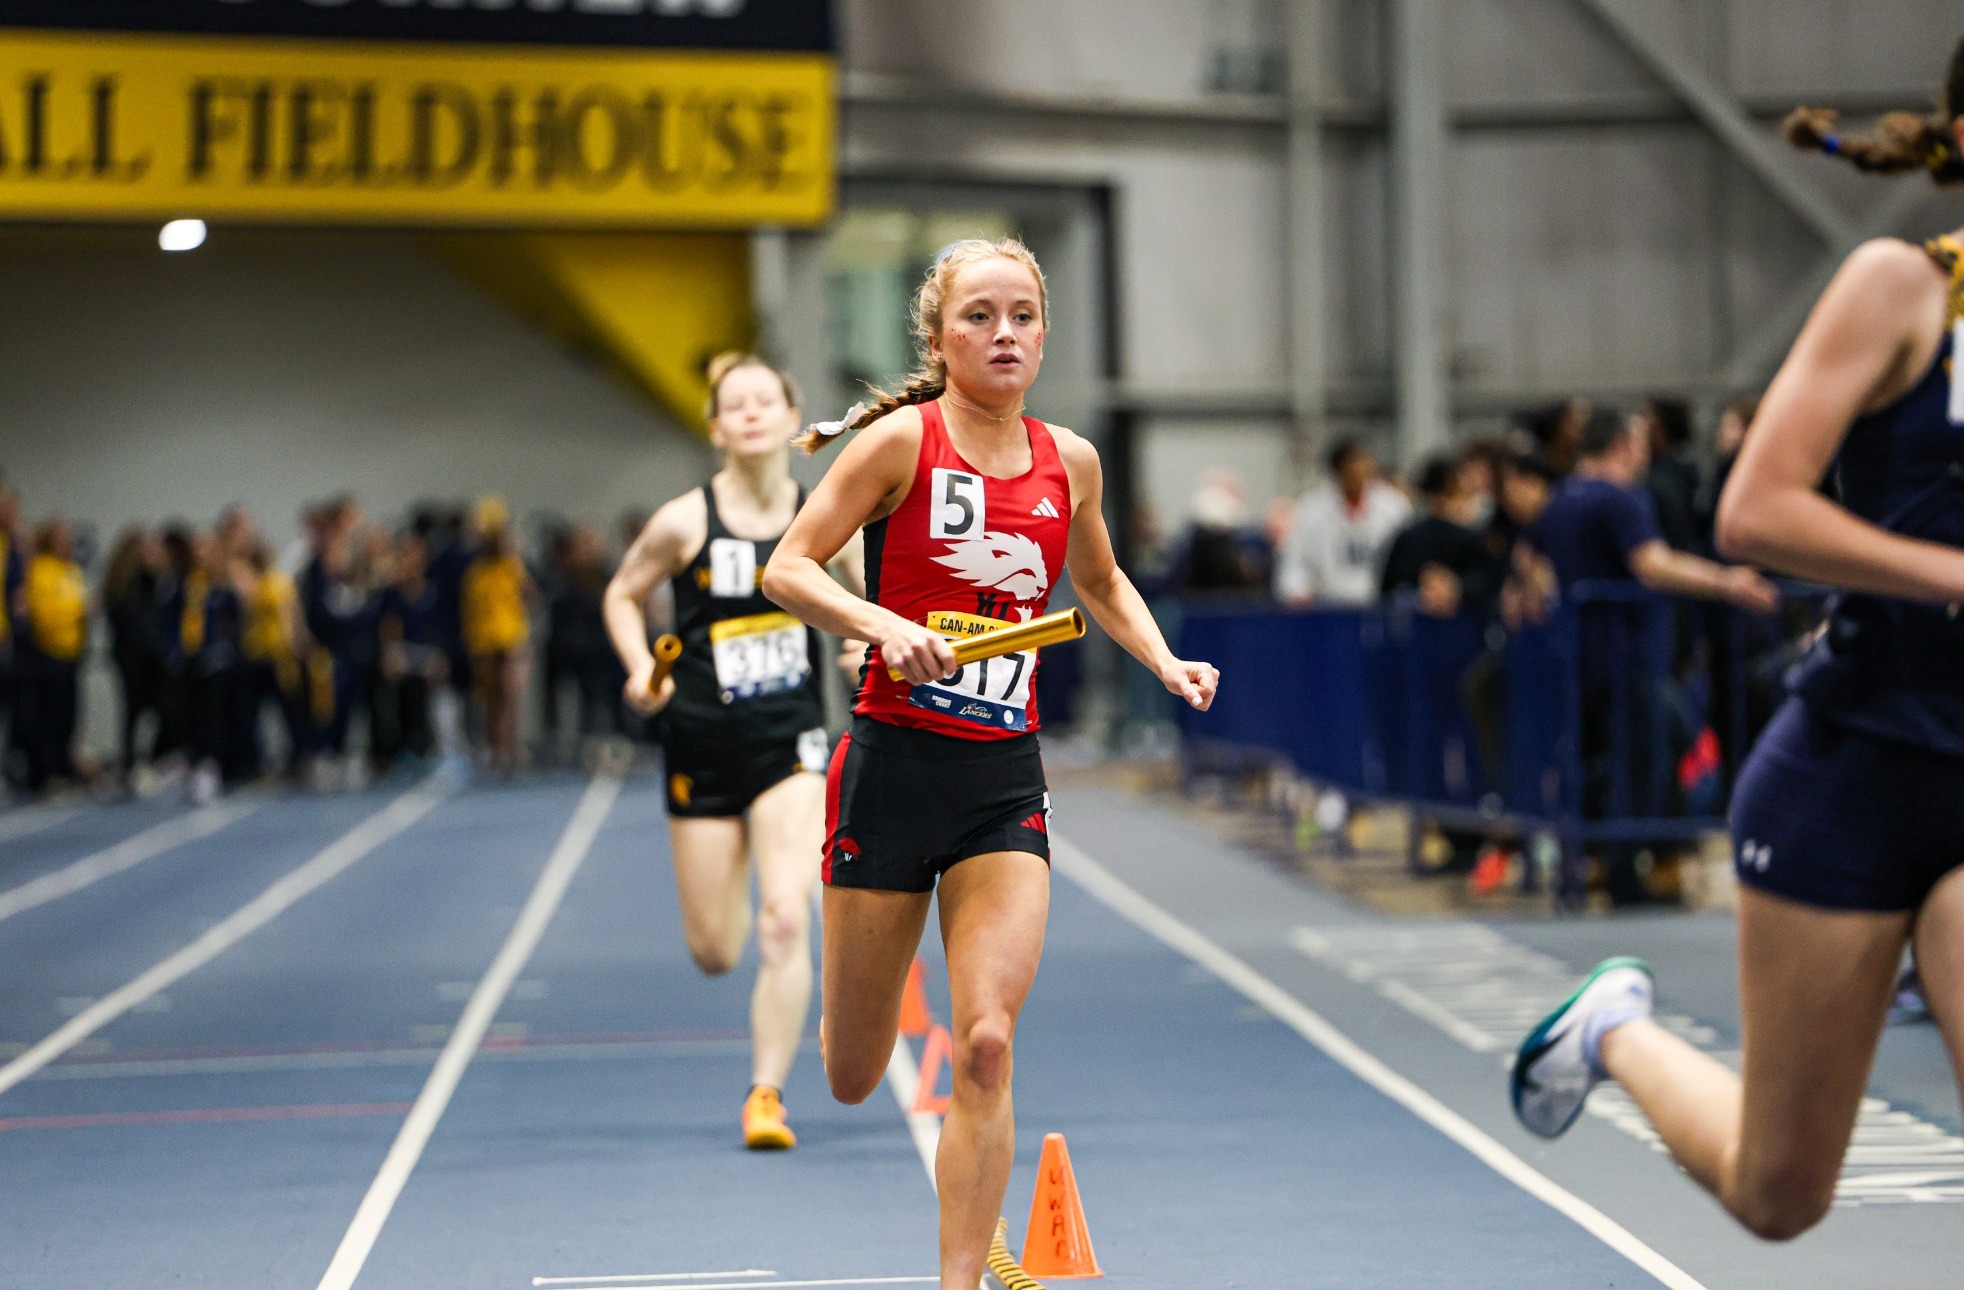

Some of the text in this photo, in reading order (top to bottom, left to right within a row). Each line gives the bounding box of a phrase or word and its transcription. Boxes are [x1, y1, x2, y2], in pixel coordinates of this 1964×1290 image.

[0, 70, 815, 194] LL FIELDHOUSE
[943, 473, 974, 536] 5
[728, 550, 740, 588] 1
[939, 617, 986, 636] CAN-AM
